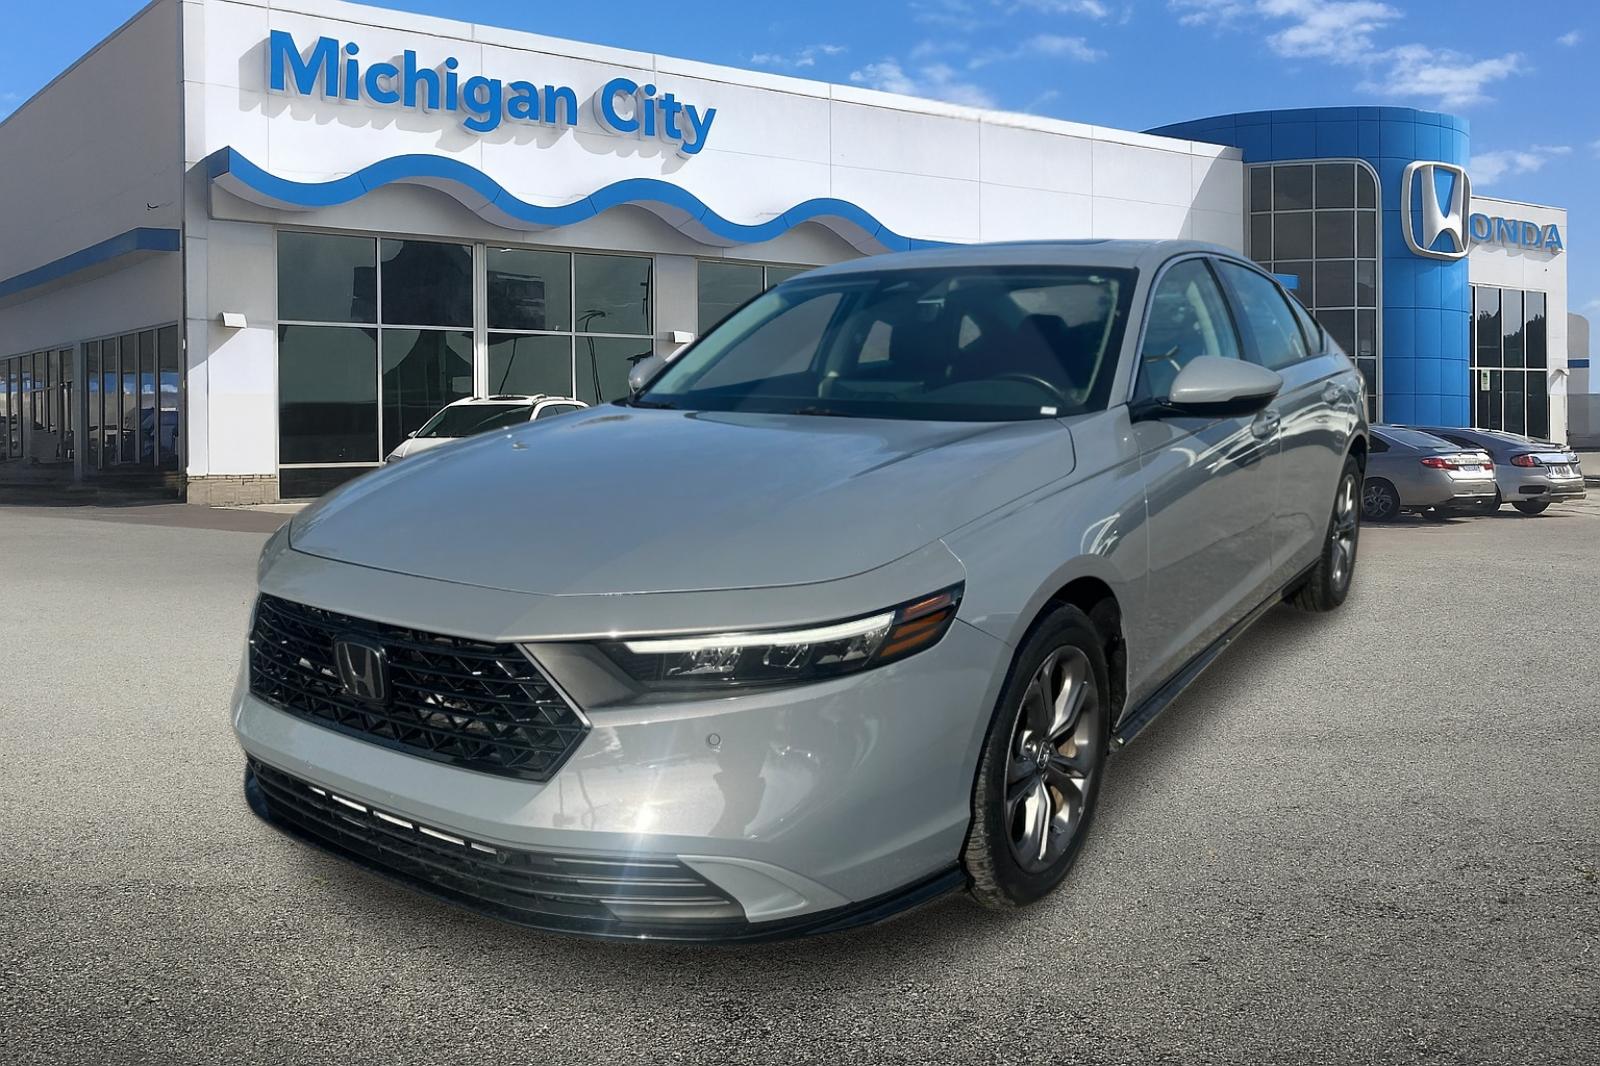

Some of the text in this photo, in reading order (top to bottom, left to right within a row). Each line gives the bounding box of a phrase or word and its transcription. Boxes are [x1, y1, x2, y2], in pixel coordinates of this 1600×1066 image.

[269, 29, 717, 155] Michigan City
[1469, 212, 1564, 249] ONDA
